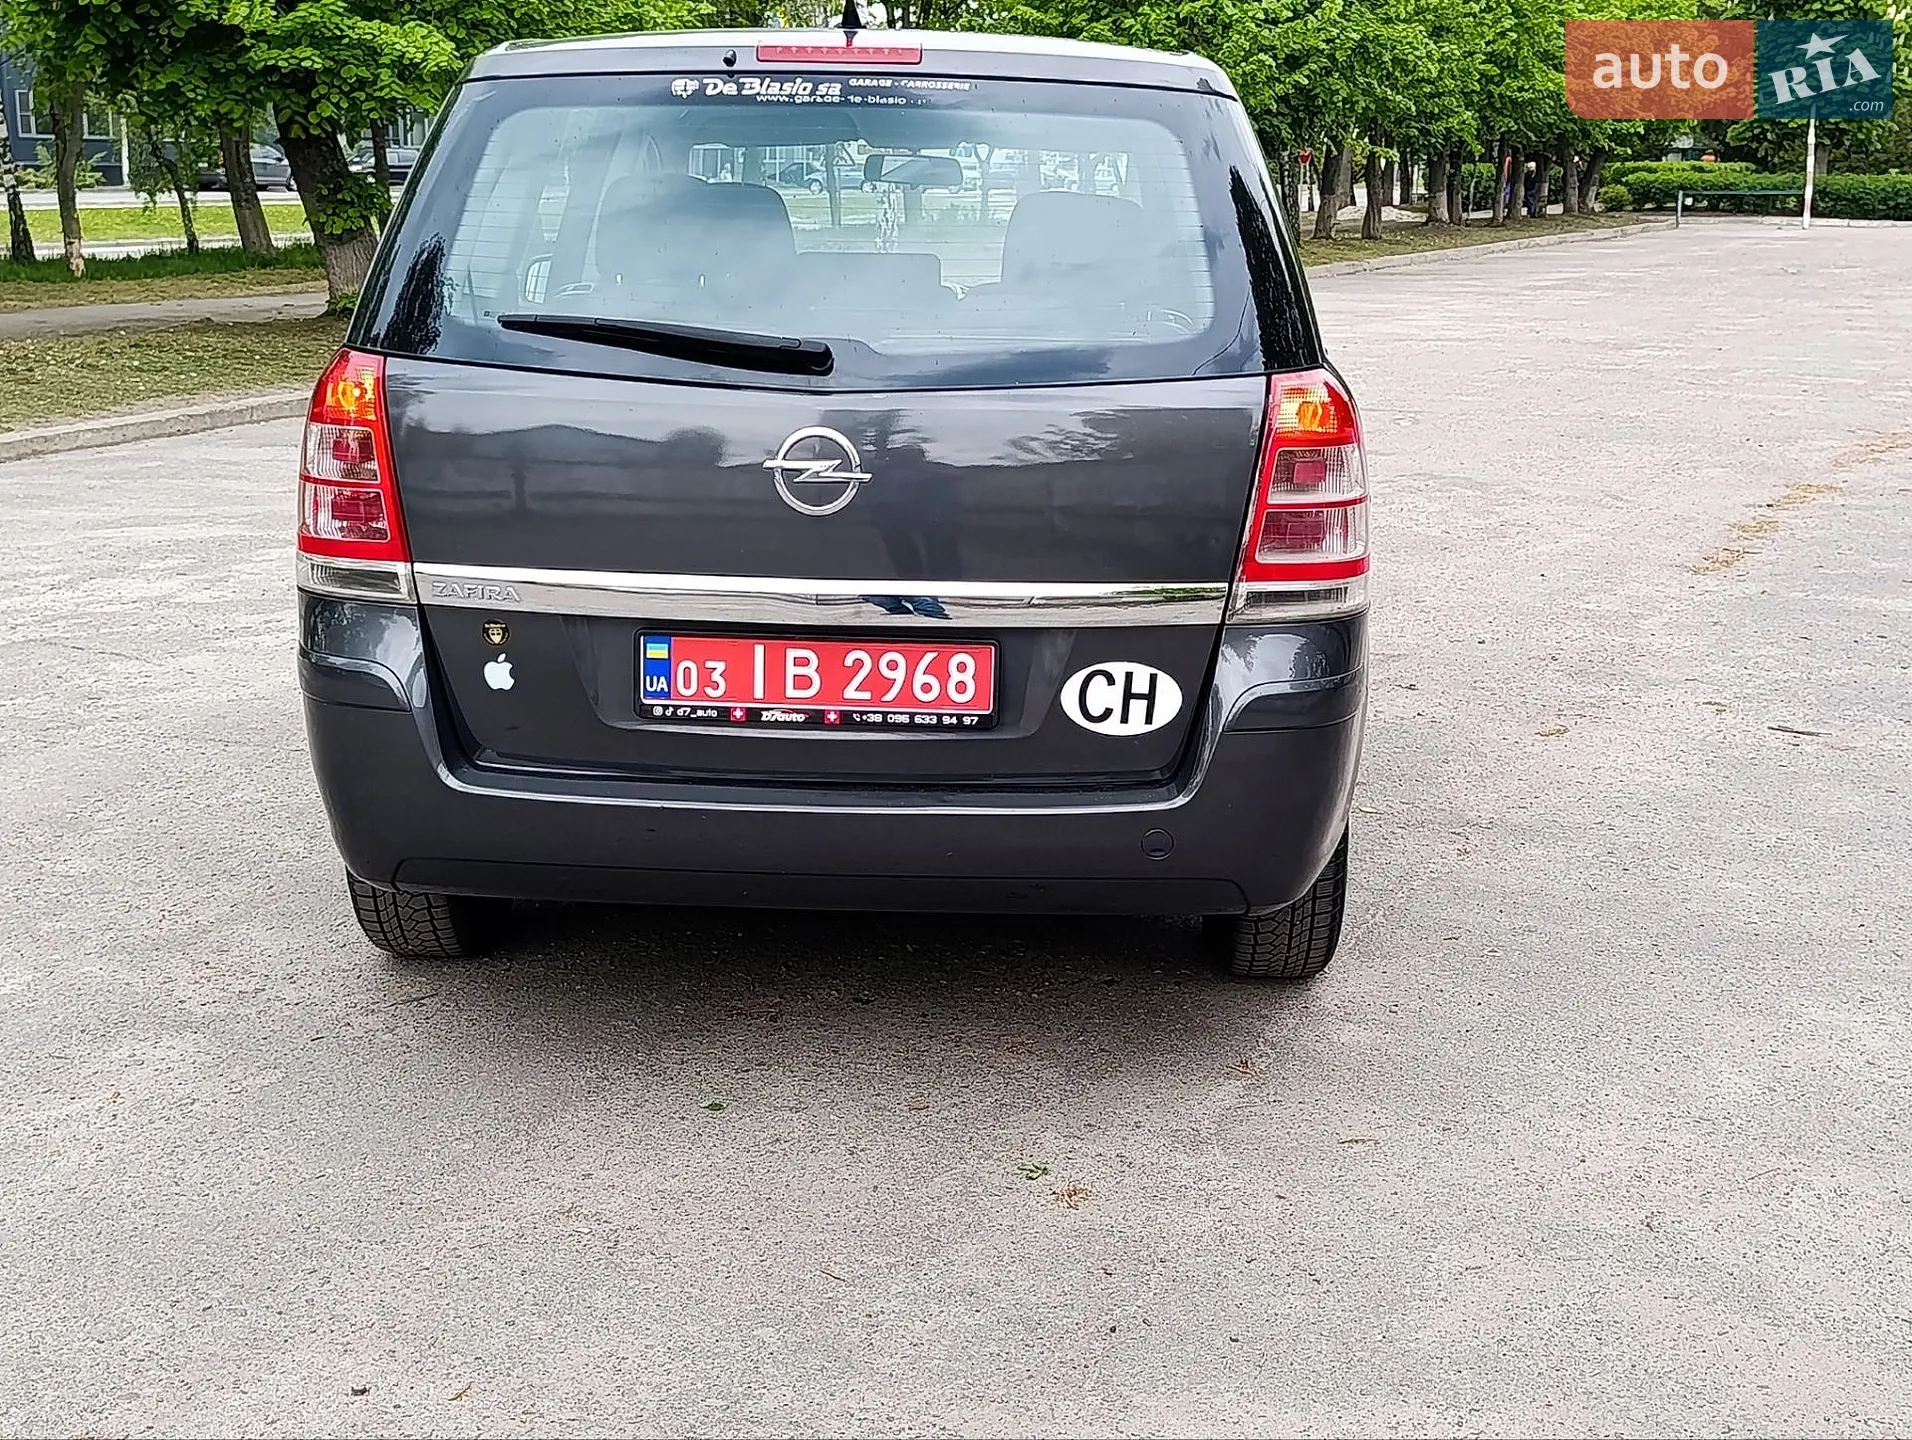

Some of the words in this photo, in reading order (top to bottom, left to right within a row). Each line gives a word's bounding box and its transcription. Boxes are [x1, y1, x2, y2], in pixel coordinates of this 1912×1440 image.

[815, 82, 842, 96] sa
[849, 78, 893, 88] GARAGE
[900, 79, 971, 91] CARROSSERIE
[432, 581, 520, 602] ZAFIRA
[675, 659, 727, 698] 03
[753, 643, 822, 700] IB
[842, 649, 977, 704] 2968
[645, 677, 669, 693] UA
[1078, 669, 1158, 725] CH
[677, 707, 718, 718] d7_auto
[862, 713, 883, 723] +38
[962, 716, 979, 725] 97
